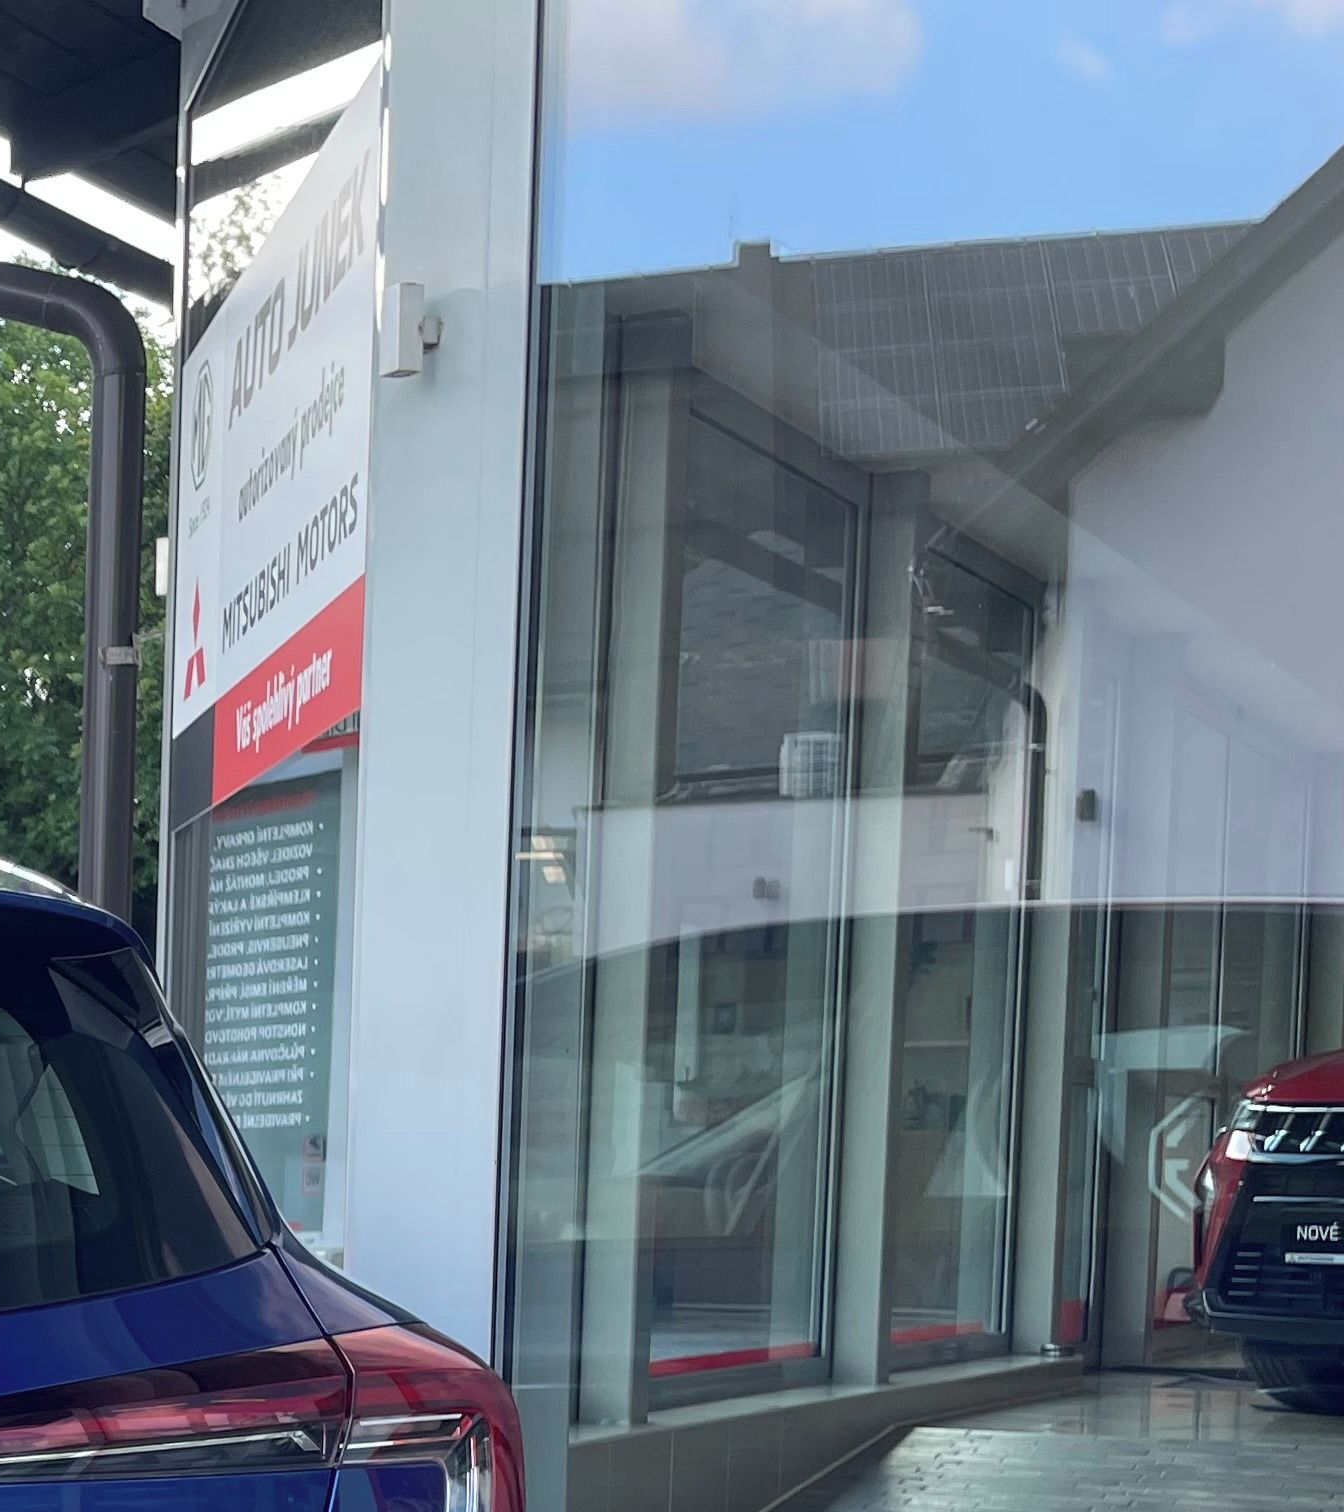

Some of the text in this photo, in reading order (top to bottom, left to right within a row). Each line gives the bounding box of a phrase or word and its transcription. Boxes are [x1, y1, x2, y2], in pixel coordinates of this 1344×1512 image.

[228, 147, 371, 431] AUTO JUNEK
[238, 361, 345, 523] autorizovaný prodejce
[222, 472, 358, 654] MITSUBISHI MOTORS
[235, 648, 332, 753] Váš spolehlivý partner
[1297, 1221, 1339, 1241] NOVÉ
